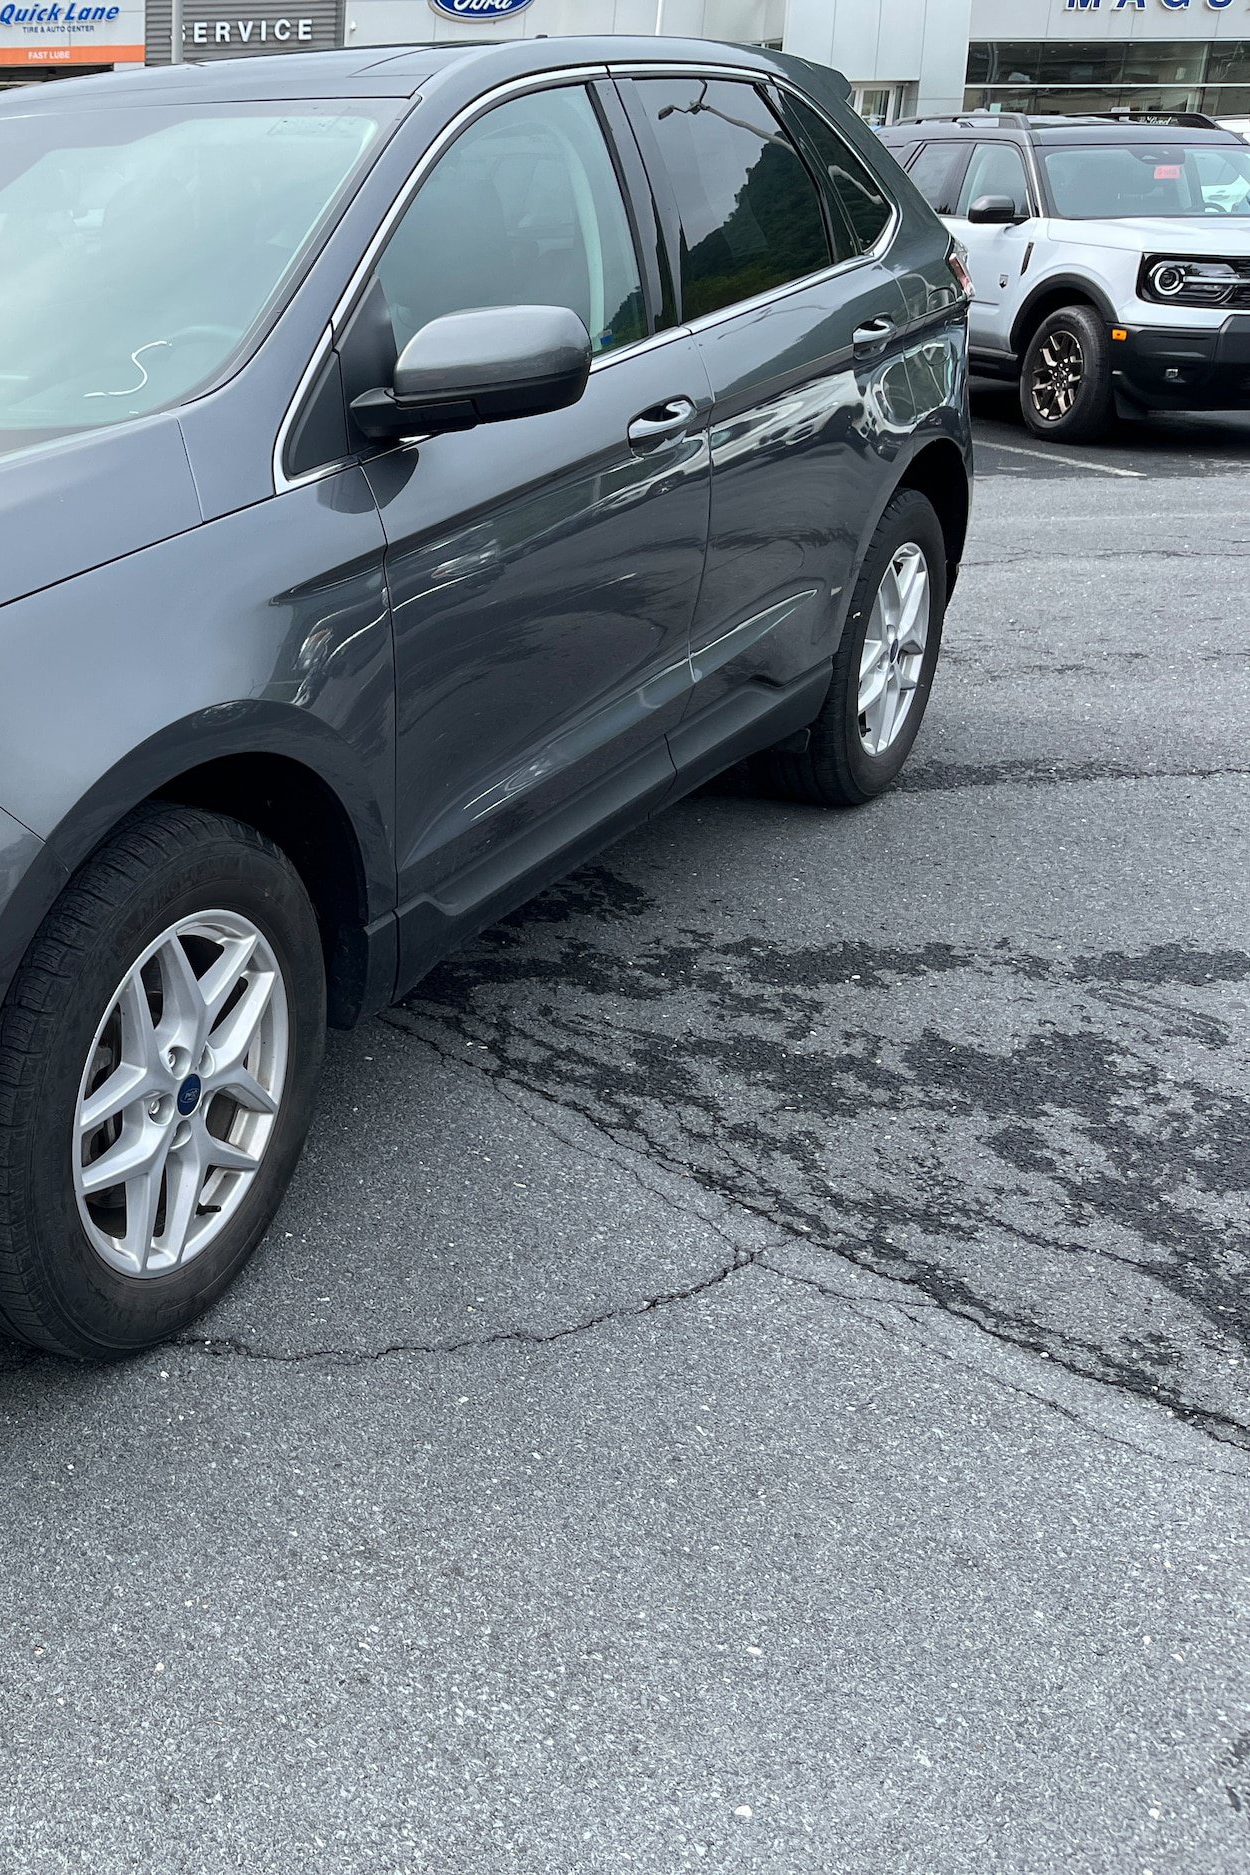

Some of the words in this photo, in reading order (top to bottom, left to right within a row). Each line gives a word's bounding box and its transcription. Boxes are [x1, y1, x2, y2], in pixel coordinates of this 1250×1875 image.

[0, 3, 61, 26] Quick
[64, 3, 120, 21] Lane
[67, 25, 94, 33] CENTER
[49, 51, 70, 59] LUBE
